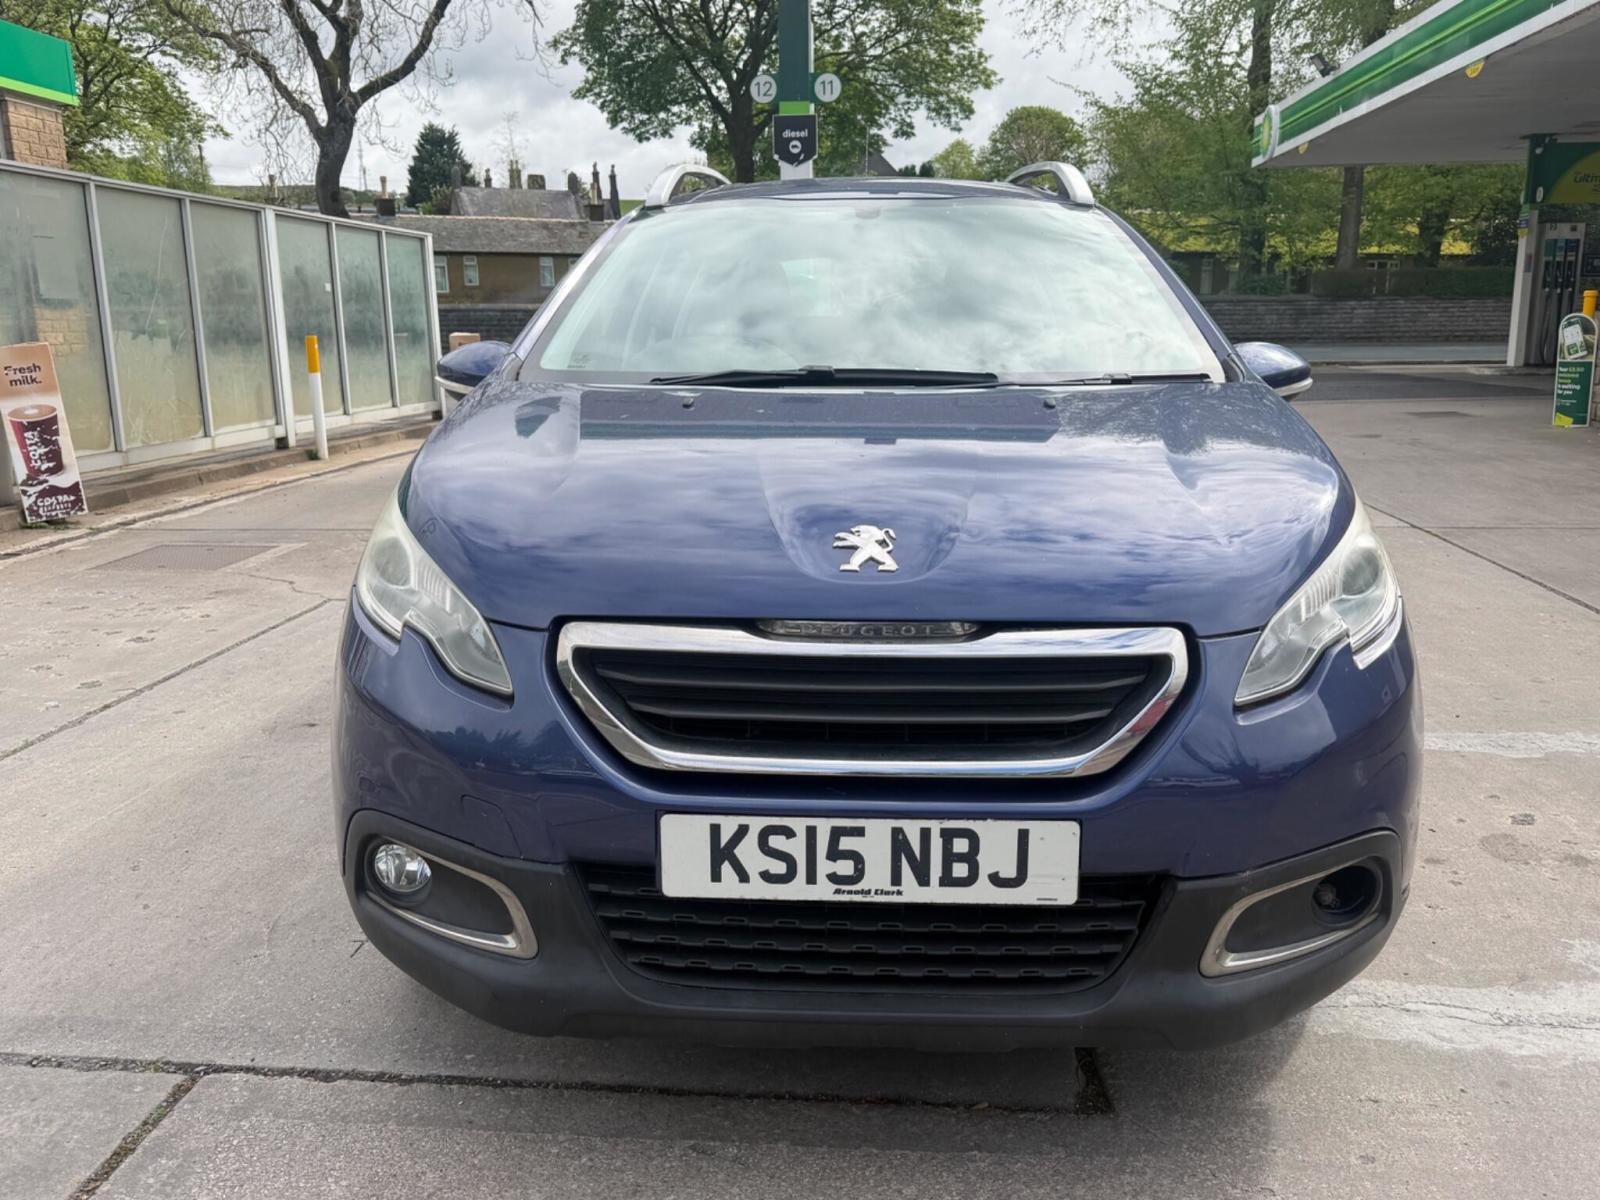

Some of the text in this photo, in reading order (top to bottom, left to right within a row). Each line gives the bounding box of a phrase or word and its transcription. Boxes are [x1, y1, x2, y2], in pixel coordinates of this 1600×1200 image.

[754, 81, 773, 97] 12
[820, 80, 833, 96] 11
[782, 129, 808, 138] diesel
[4, 363, 41, 376] Fresh
[9, 374, 42, 387] milk.
[799, 624, 935, 636] PEUGEOT
[709, 823, 1030, 889] KS15 NBJ
[832, 888, 904, 896] Arnold Clark
